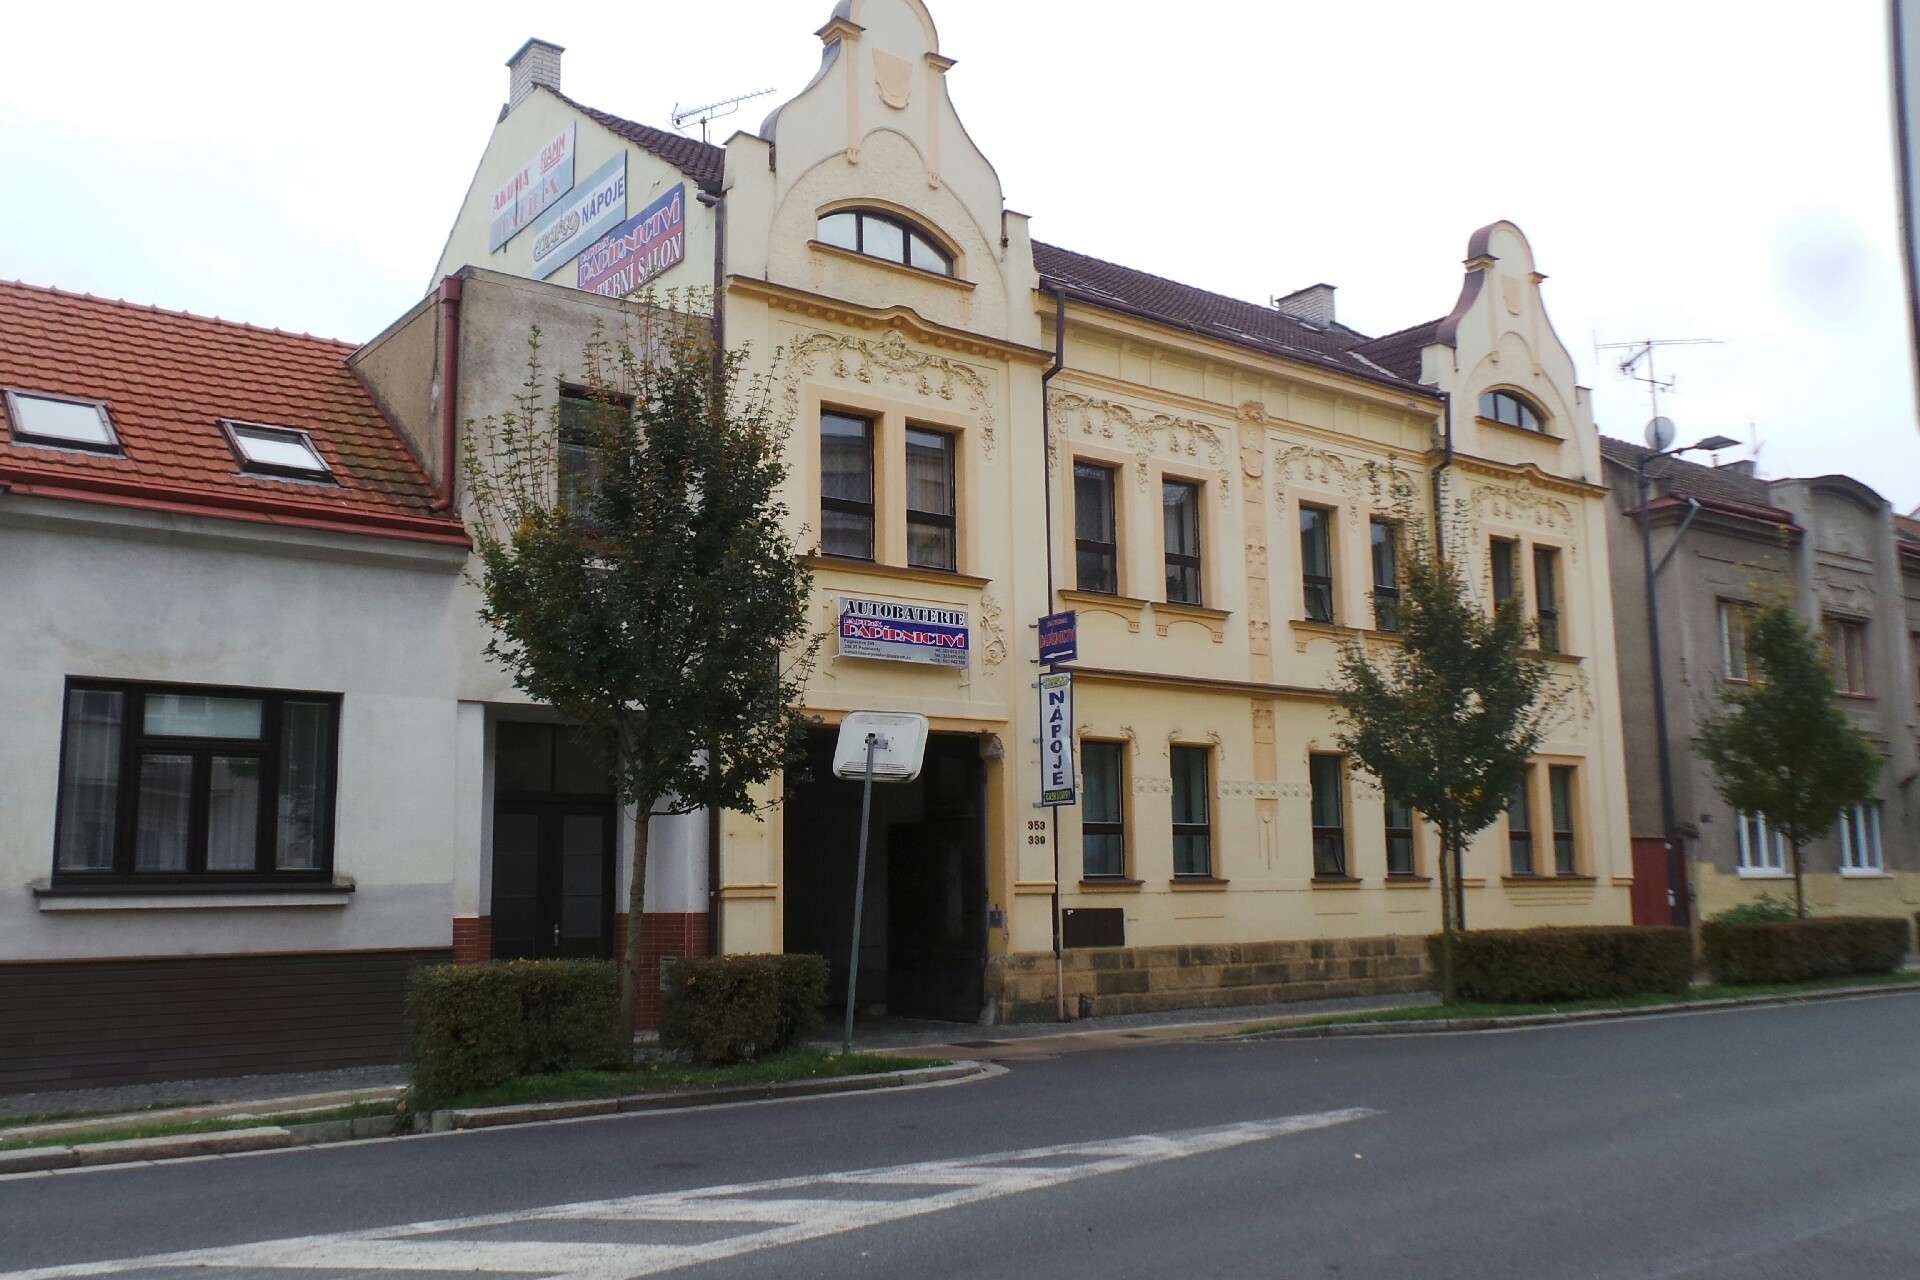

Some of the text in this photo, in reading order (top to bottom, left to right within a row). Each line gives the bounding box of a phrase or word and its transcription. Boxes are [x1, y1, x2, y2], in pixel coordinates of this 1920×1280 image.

[582, 175, 625, 225] NÁPOJE
[579, 191, 681, 287] PAPÍRNICTVÍ
[593, 232, 682, 299] TEBNÍ SALON
[843, 600, 965, 626] AUTOBATERIE
[844, 623, 965, 648] PAPÍRNICTVÍ
[1049, 690, 1064, 786] NÁPOJE
[1028, 821, 1046, 830] 353
[1028, 835, 1046, 845] 339
